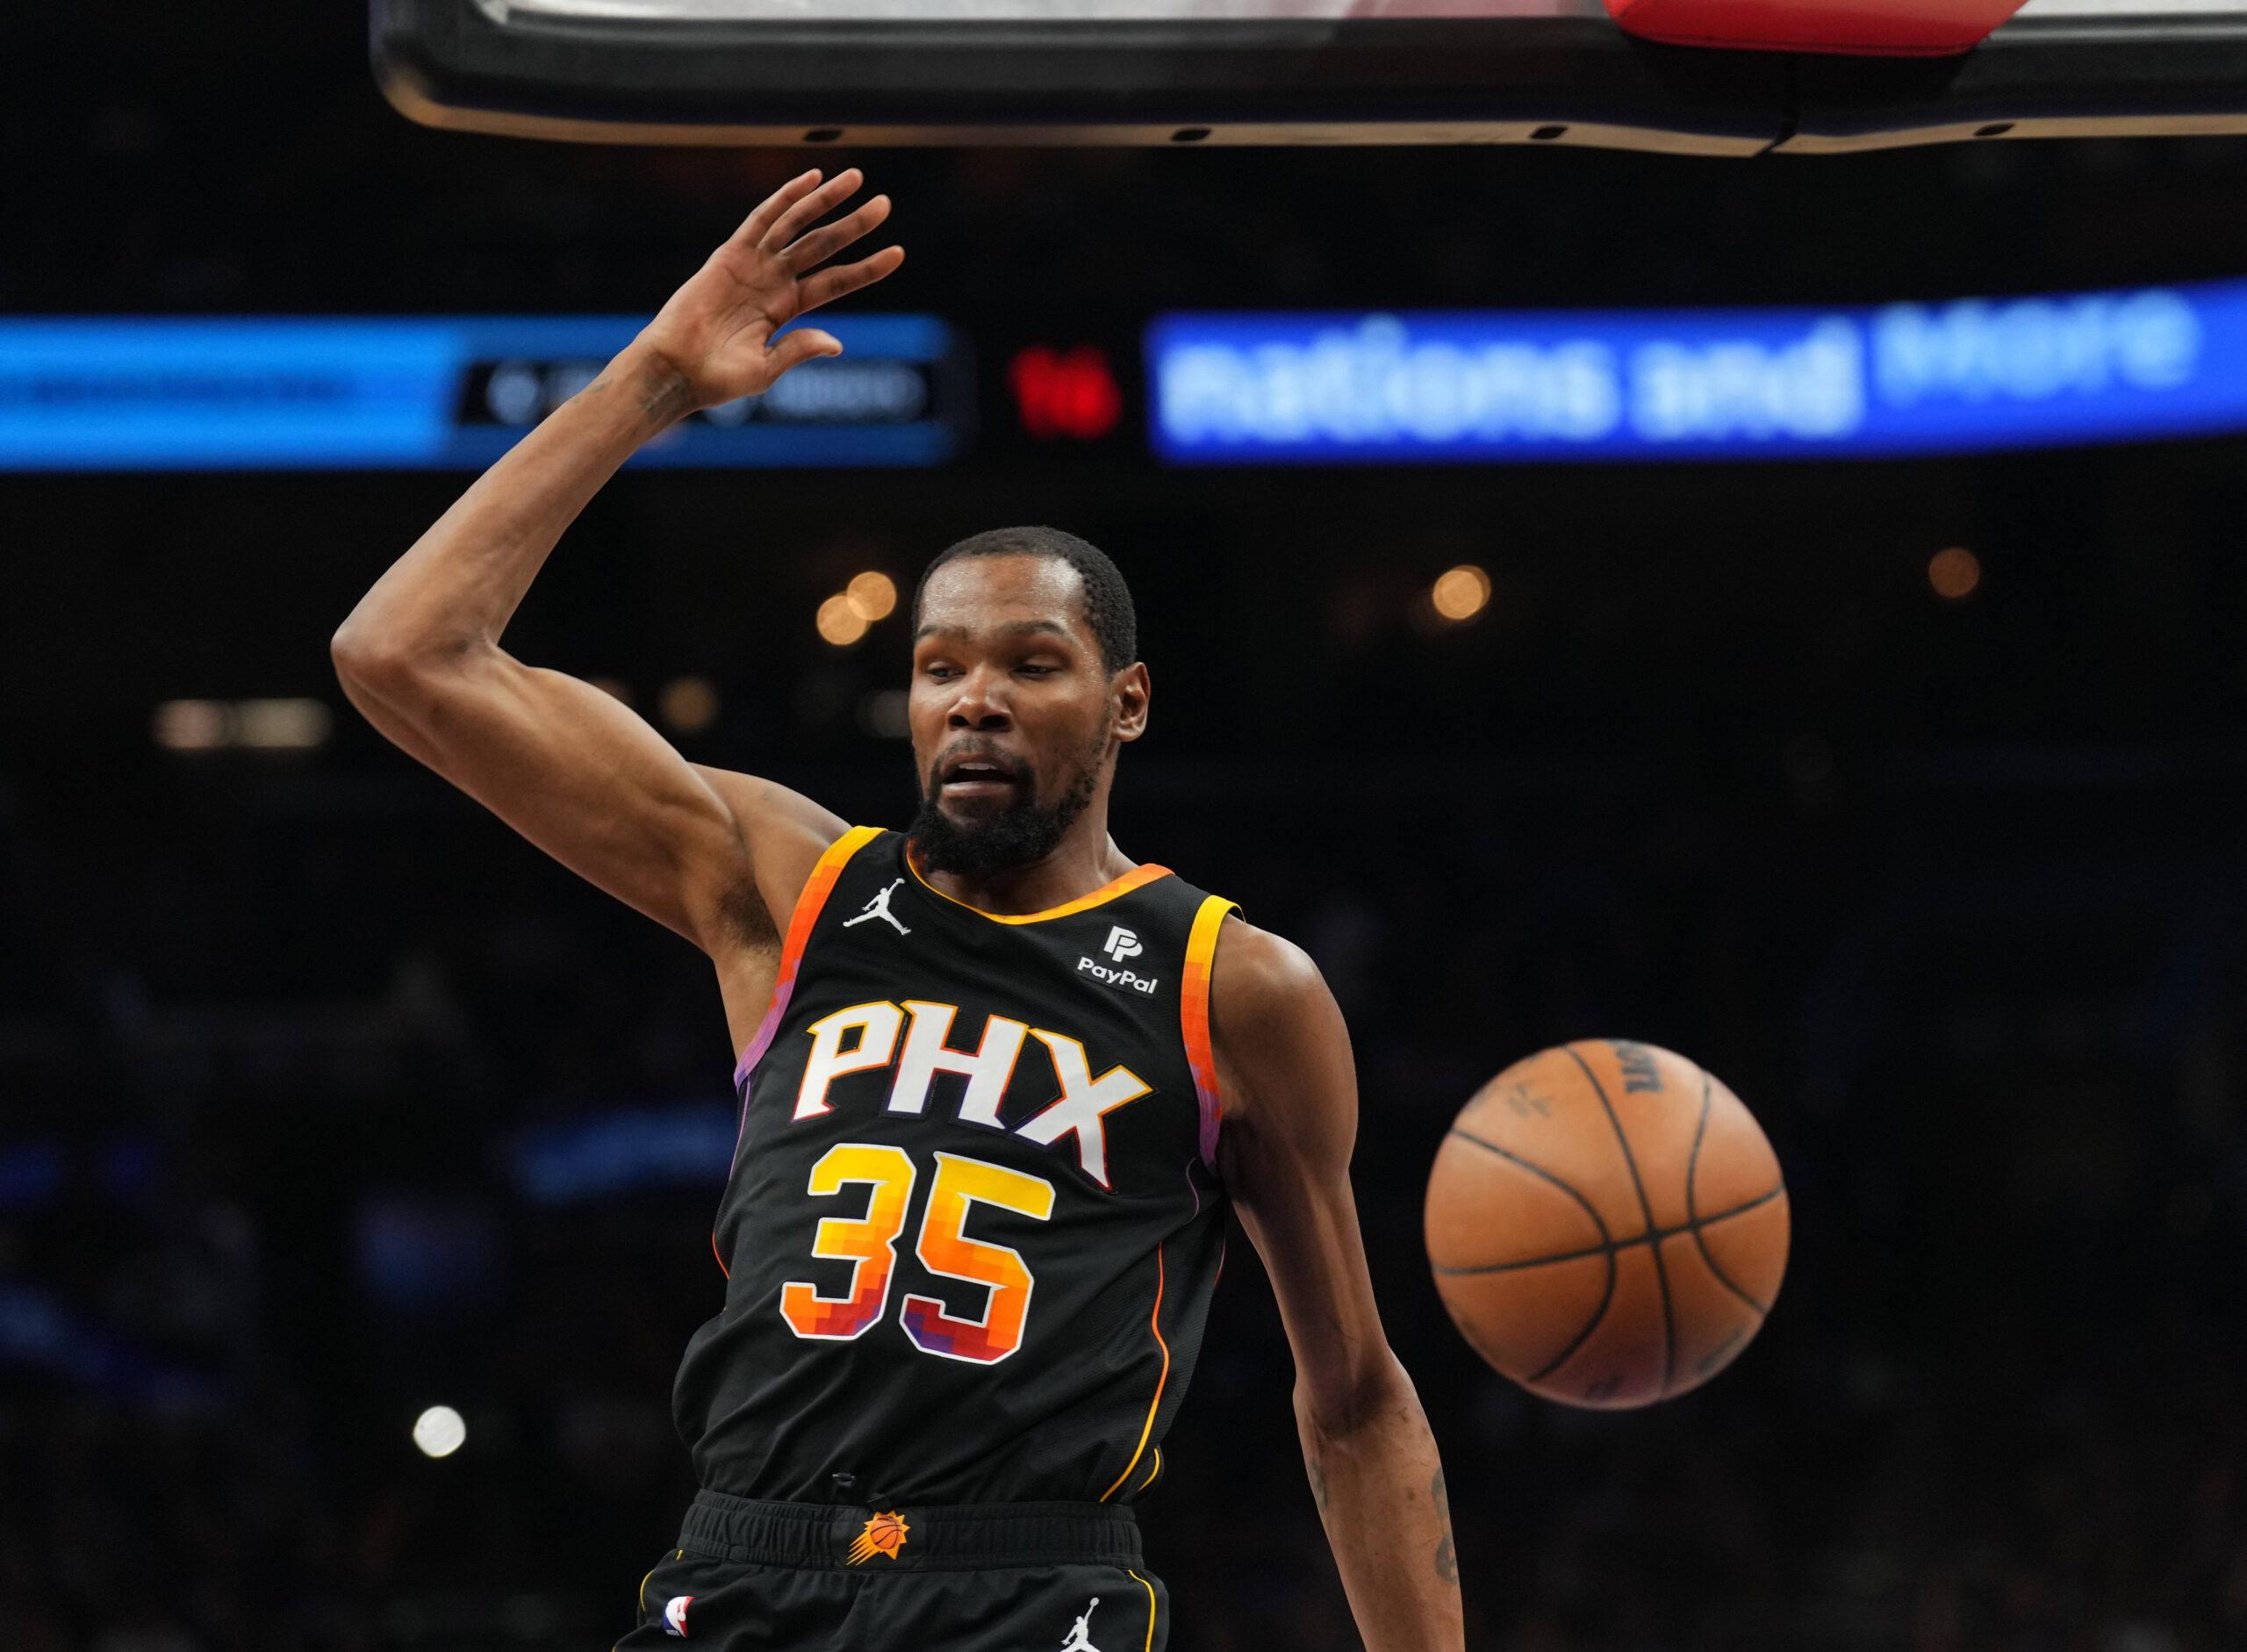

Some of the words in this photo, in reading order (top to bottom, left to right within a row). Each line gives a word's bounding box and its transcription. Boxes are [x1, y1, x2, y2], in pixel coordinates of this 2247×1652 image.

[1162, 316, 1616, 441] nations
[1633, 318, 1863, 441] and
[1077, 957, 1158, 995] PayPal
[790, 999, 1153, 1191] PHX
[779, 1143, 1056, 1366] 35
